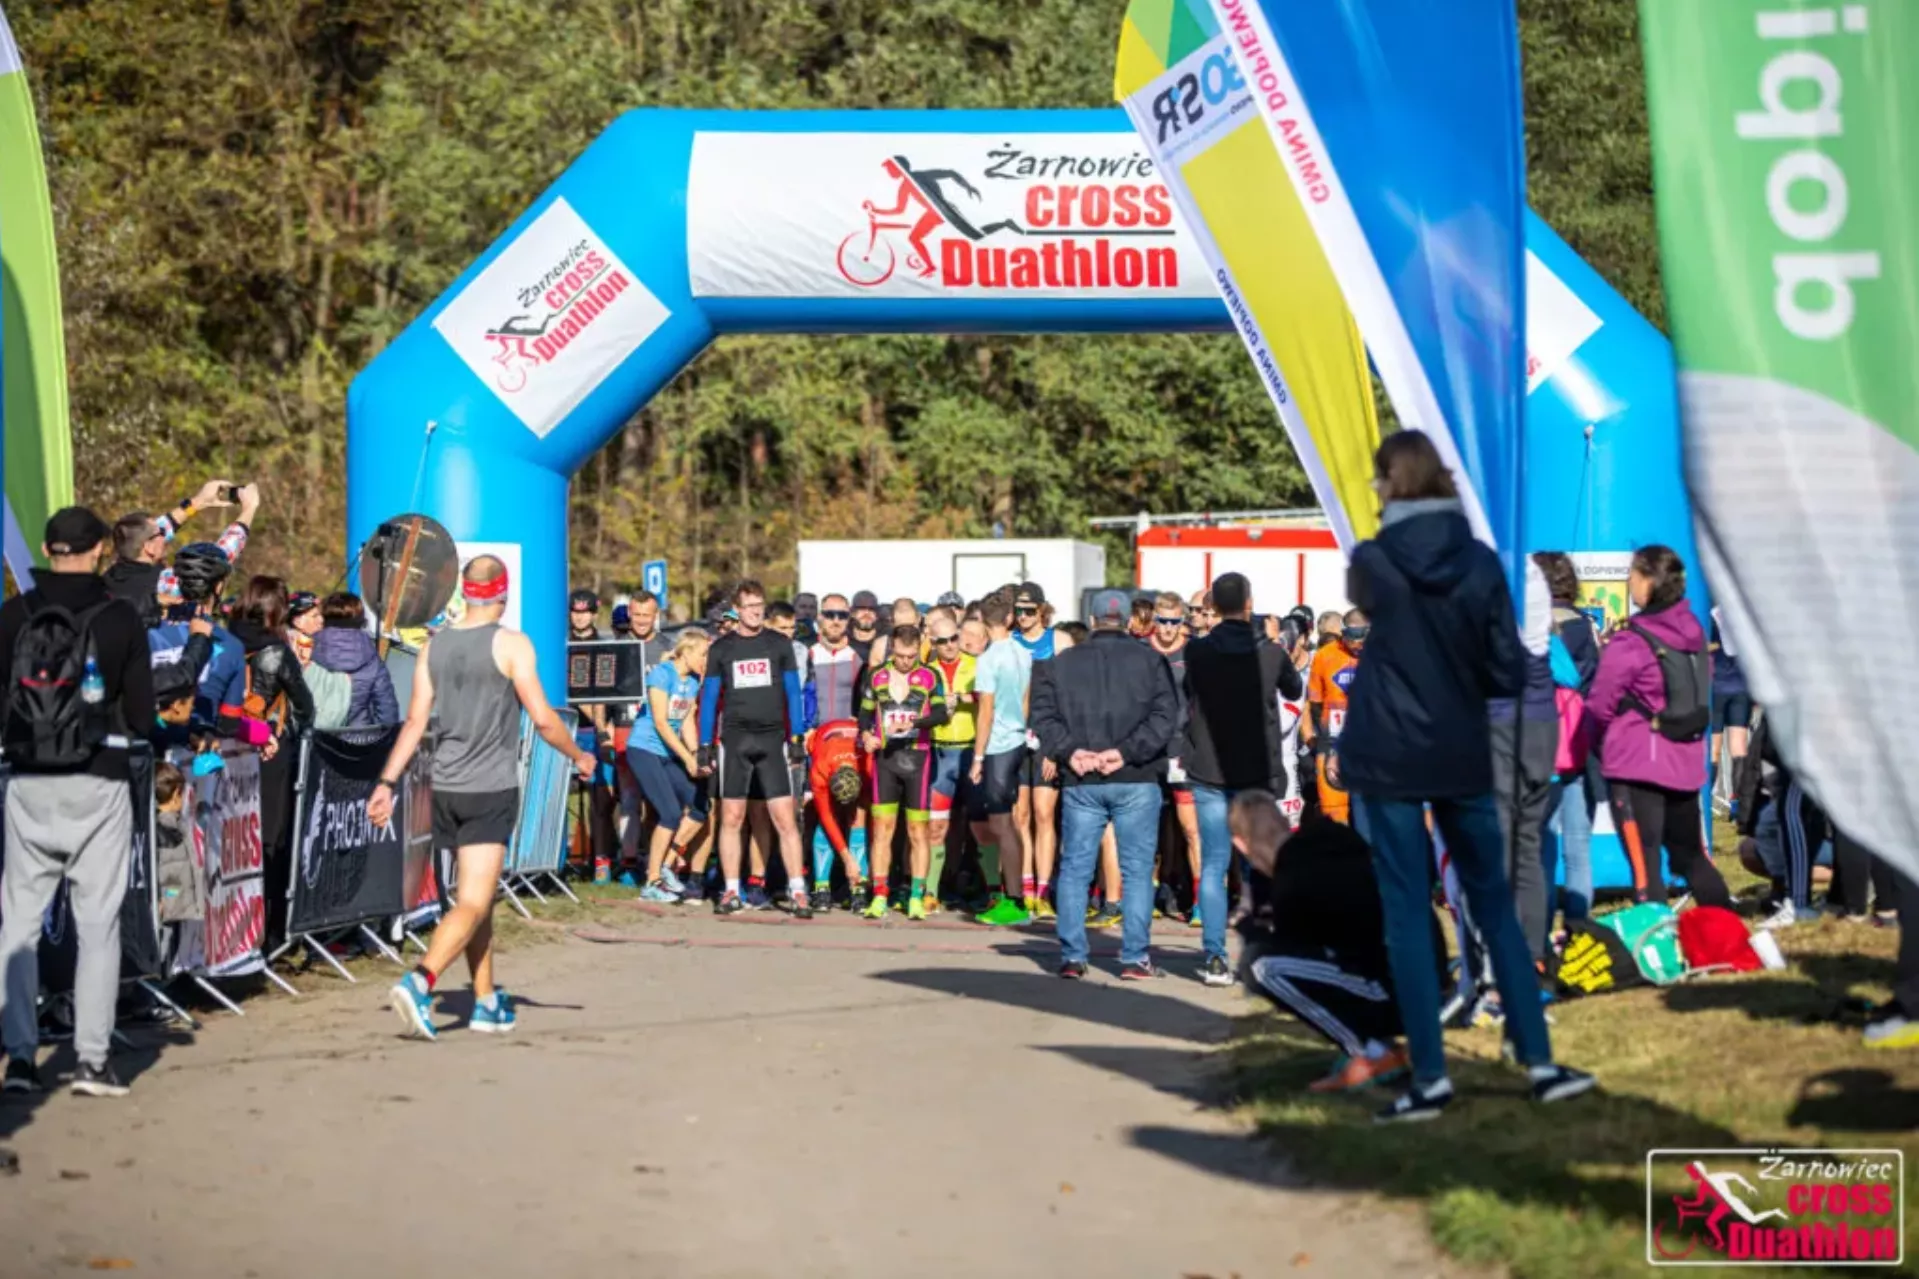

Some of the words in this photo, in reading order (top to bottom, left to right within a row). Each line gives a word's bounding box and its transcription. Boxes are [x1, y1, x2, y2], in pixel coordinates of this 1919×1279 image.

[984, 142, 1153, 180] Żarnowie
[1025, 184, 1172, 227] cross
[517, 239, 590, 308] Żarnowiec
[544, 250, 606, 310] cross
[941, 238, 1179, 288] Duathlon
[532, 270, 631, 363] Duathlon
[737, 661, 767, 675] 102
